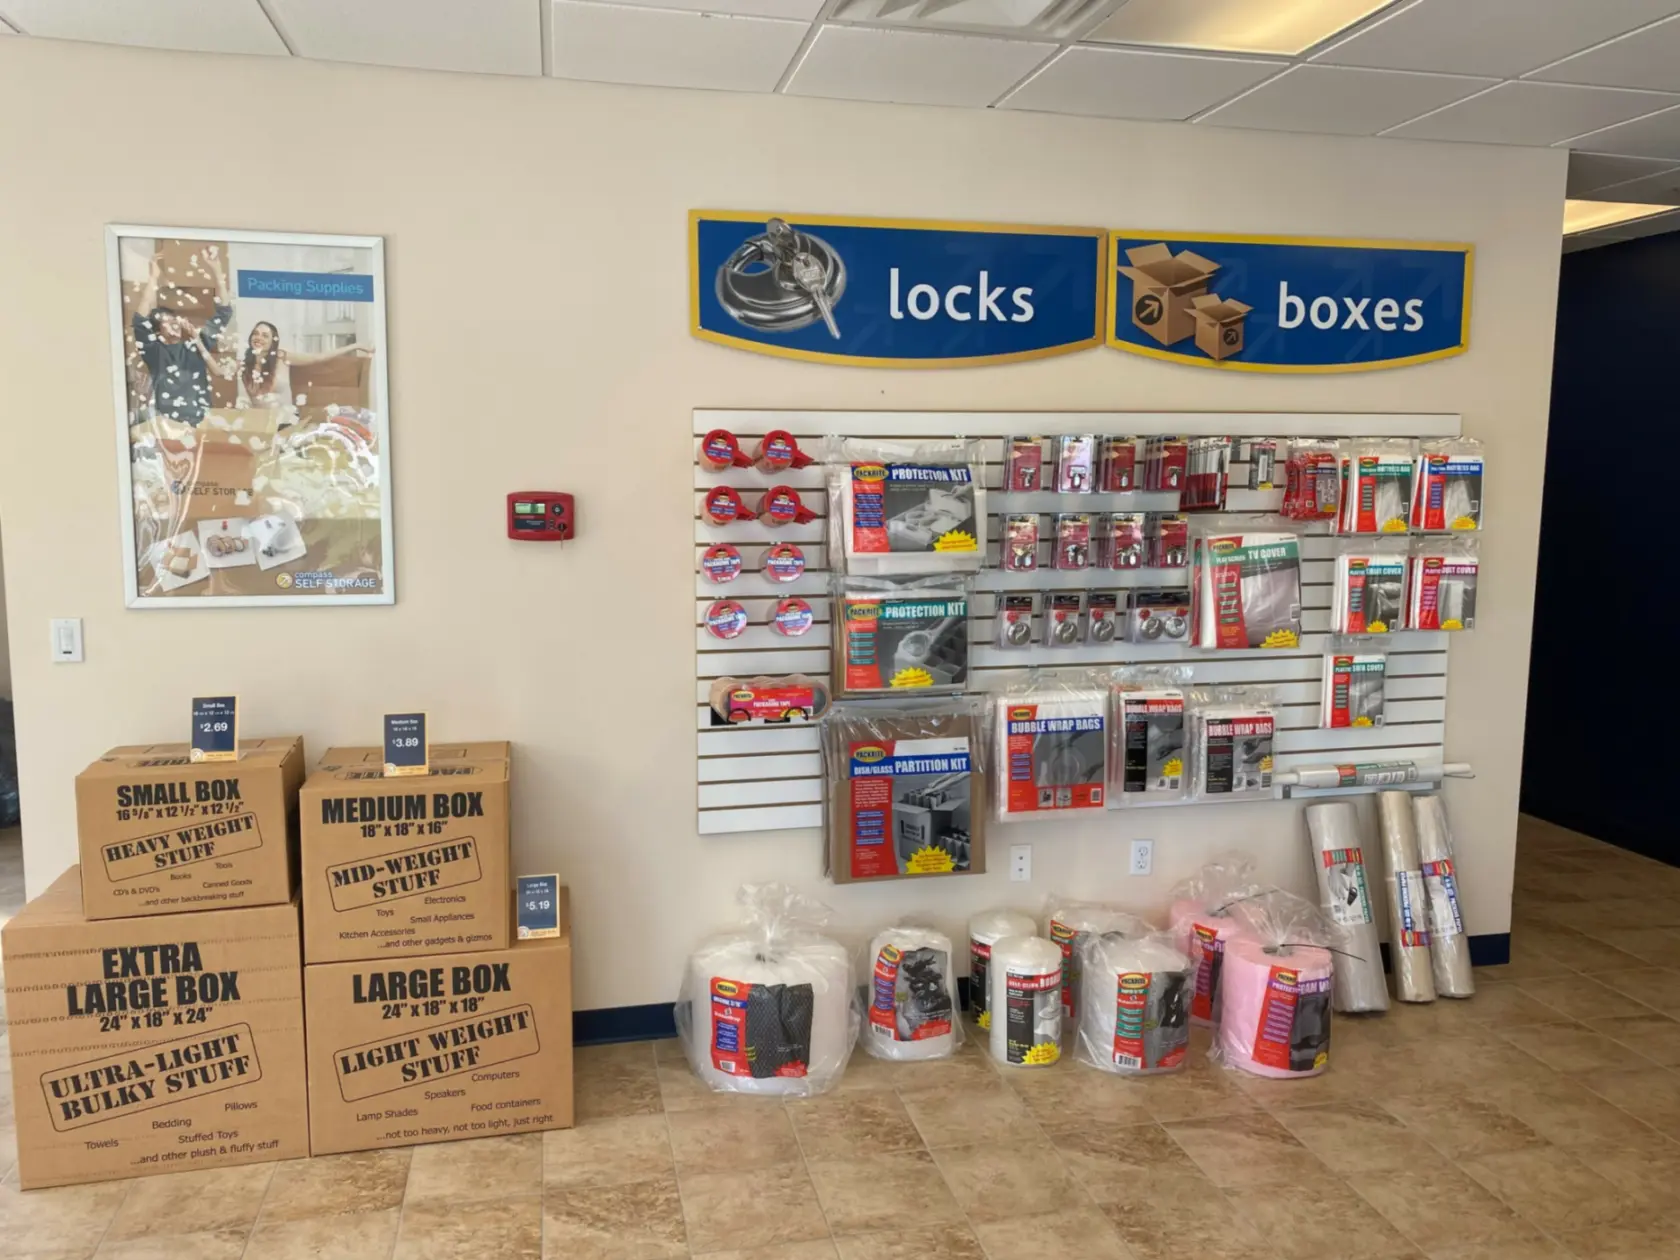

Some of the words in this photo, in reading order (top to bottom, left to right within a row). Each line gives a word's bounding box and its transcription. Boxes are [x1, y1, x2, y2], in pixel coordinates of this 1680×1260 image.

[247, 277, 302, 295] Packing
[305, 280, 364, 296] Supplies
[888, 267, 1035, 322] locks
[1278, 279, 1424, 333] boxes
[892, 468, 949, 481] PROTECTION
[949, 468, 968, 481] KIT
[1248, 550, 1259, 560] TV
[1260, 547, 1287, 558] COVER
[295, 579, 323, 589] SELF
[325, 578, 376, 588] STORAGE
[885, 605, 945, 618] PROTECTION
[947, 602, 965, 615] KIT
[200, 722, 228, 732] $2.69
[1011, 721, 1046, 733] BUBBLE
[1047, 720, 1074, 732] WRAP
[1076, 718, 1101, 730] BAGS
[1208, 725, 1234, 736] BUBBLE
[1234, 723, 1253, 735] WRAP
[1255, 722, 1272, 734] BAGS
[392, 737, 419, 748] $3.89
[854, 766, 893, 775] DISH/GLASS
[895, 759, 948, 773] PARTITION
[950, 758, 967, 770] KIT
[116, 781, 190, 807] SMALL
[195, 778, 241, 801] BOX
[116, 809, 131, 821] 16
[166, 805, 178, 817] 12
[210, 803, 223, 814] 12
[321, 794, 426, 824] MEDIUM
[433, 791, 484, 818] BOX
[360, 824, 382, 838] 18"
[394, 822, 415, 836] 18"
[427, 820, 448, 835] 16"
[106, 834, 170, 863] HEAVY
[176, 815, 254, 845] WEIGHT
[154, 842, 215, 869] STUFF
[331, 842, 472, 888] MID-WEIGHT
[170, 873, 192, 881] Books
[202, 881, 229, 889] Canned
[230, 879, 253, 887] Goods
[372, 869, 441, 898] STUFF
[160, 897, 179, 905] other
[180, 893, 227, 903] backbreaking
[229, 891, 245, 899] stuff
[424, 895, 466, 904] Electronics
[525, 900, 550, 911] $5.19
[376, 909, 394, 918] Toys
[410, 915, 432, 924] Small
[433, 913, 475, 923] Appliances
[339, 930, 369, 940] Kitchen
[370, 927, 416, 938] Accessories
[402, 938, 422, 947] other
[424, 936, 455, 948] gadgets
[457, 935, 464, 943] &
[466, 933, 492, 944] gizmos
[102, 941, 203, 979] EXTRA
[353, 968, 445, 1004] LARGE
[452, 962, 511, 996] BOX
[67, 978, 168, 1017] LARGE
[176, 970, 241, 1006] BOX
[382, 1002, 409, 1020] 24"
[422, 1000, 447, 1016] 18"
[460, 996, 485, 1013] 18"
[99, 1014, 128, 1033] 24"
[143, 1011, 170, 1028] 18"
[186, 1007, 213, 1024] 24"
[340, 1037, 420, 1075] LIGHT
[428, 1010, 529, 1052] WEIGHT
[49, 1034, 240, 1099] ULTRA-LIGHT
[401, 1046, 480, 1083] STUFF
[471, 1070, 520, 1083] Computers
[60, 1079, 156, 1122] BULKY
[165, 1055, 250, 1094] STUFF
[424, 1088, 466, 1100] Speakers
[224, 1101, 258, 1112] Pillows
[471, 1102, 493, 1112] Food
[495, 1098, 541, 1110] containers
[356, 1111, 382, 1123] Lamp
[384, 1108, 418, 1119] Shades
[152, 1118, 192, 1131] Bedding
[403, 1128, 419, 1138] too
[421, 1125, 451, 1137] heavy,
[452, 1123, 469, 1133] not
[470, 1122, 486, 1131] too
[488, 1118, 511, 1131] light,
[512, 1116, 530, 1128] just
[532, 1114, 553, 1126] right
[178, 1132, 214, 1144] Stuffed
[216, 1129, 239, 1141] Toys
[84, 1139, 119, 1150] Towels
[161, 1150, 187, 1162] other
[190, 1147, 217, 1160] plush
[219, 1146, 227, 1155] &
[229, 1143, 255, 1155] fluffy
[257, 1139, 280, 1150] stuff
